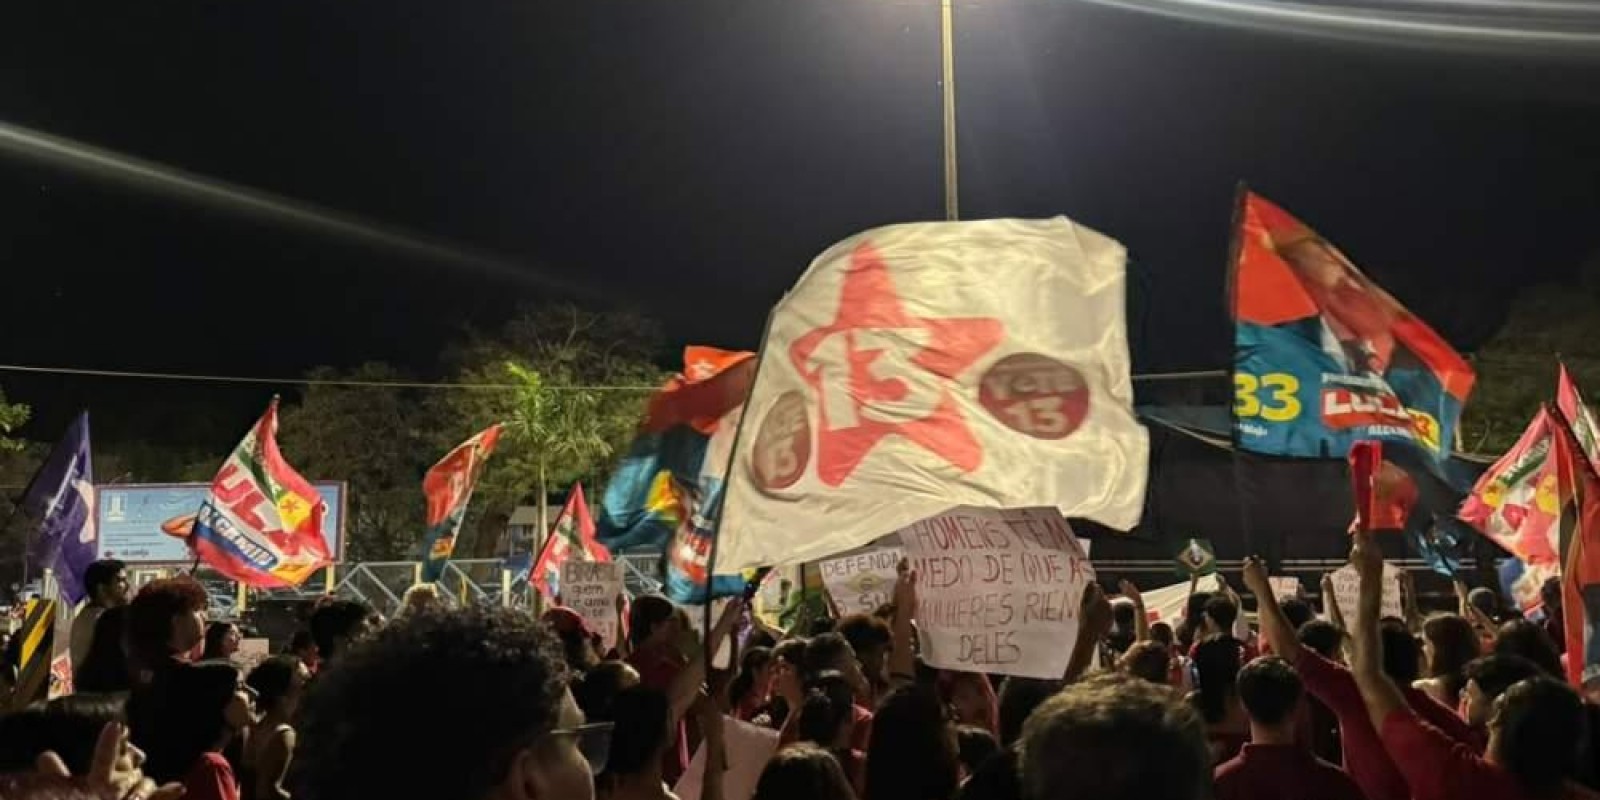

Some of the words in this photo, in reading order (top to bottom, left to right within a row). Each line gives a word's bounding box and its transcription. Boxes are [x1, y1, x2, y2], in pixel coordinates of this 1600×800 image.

[805, 328, 942, 430] 13
[1004, 397, 1068, 432] 13
[983, 554, 1013, 584] DE
[1021, 552, 1061, 584] QUE
[957, 632, 1021, 664] DELES
